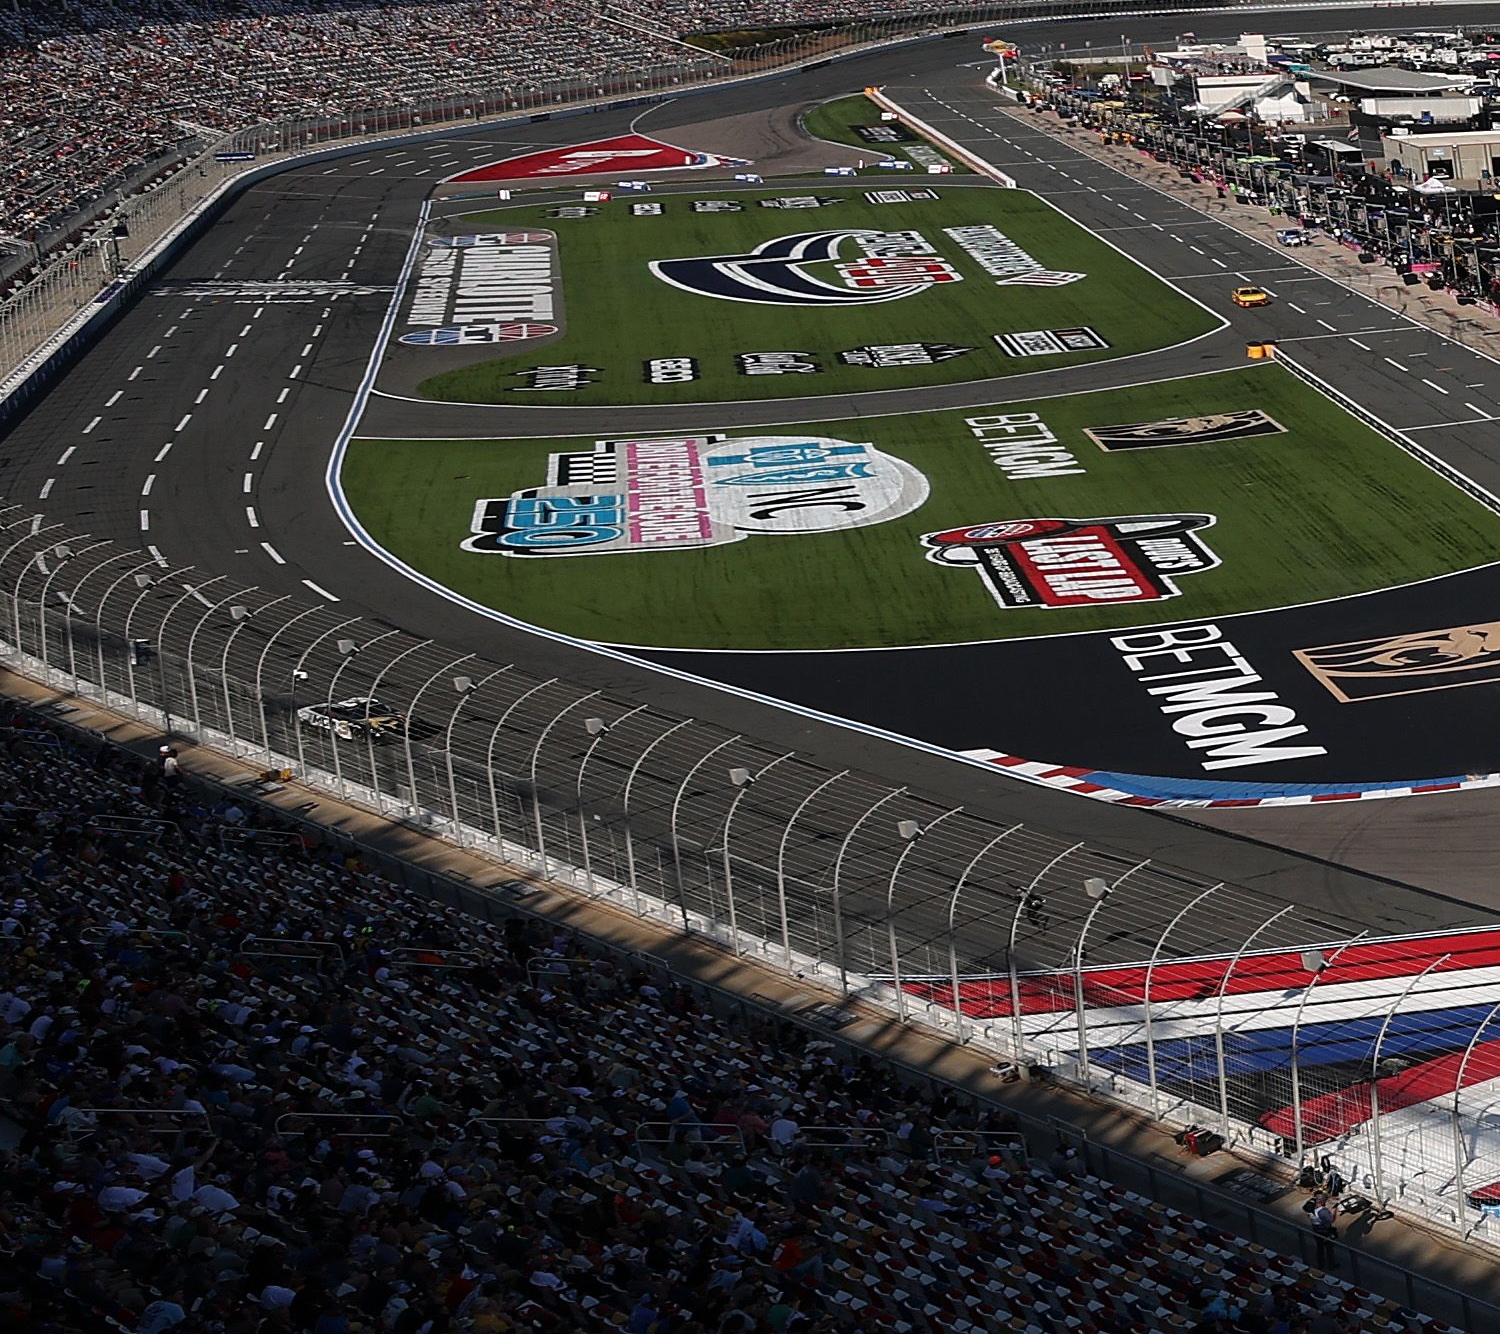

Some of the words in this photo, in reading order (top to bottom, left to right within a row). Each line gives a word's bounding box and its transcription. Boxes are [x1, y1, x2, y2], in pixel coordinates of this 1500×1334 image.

[420, 248, 459, 277] MOTOR
[834, 257, 964, 288] 400
[452, 245, 554, 323] CHARLOTTE
[407, 277, 453, 325] SPEEDWAY
[651, 358, 693, 383] GEICO
[636, 441, 690, 470] DRIVE
[964, 412, 1086, 480] BETMGM
[637, 470, 694, 489] FOR
[638, 489, 697, 511] THE
[747, 485, 867, 521] NC
[497, 494, 625, 547] 250
[638, 510, 702, 542] CURE
[1020, 535, 1121, 571] LAST
[1136, 536, 1204, 570] DOUG'S
[1043, 568, 1144, 600] LAP
[1108, 623, 1329, 772] BETMGM
